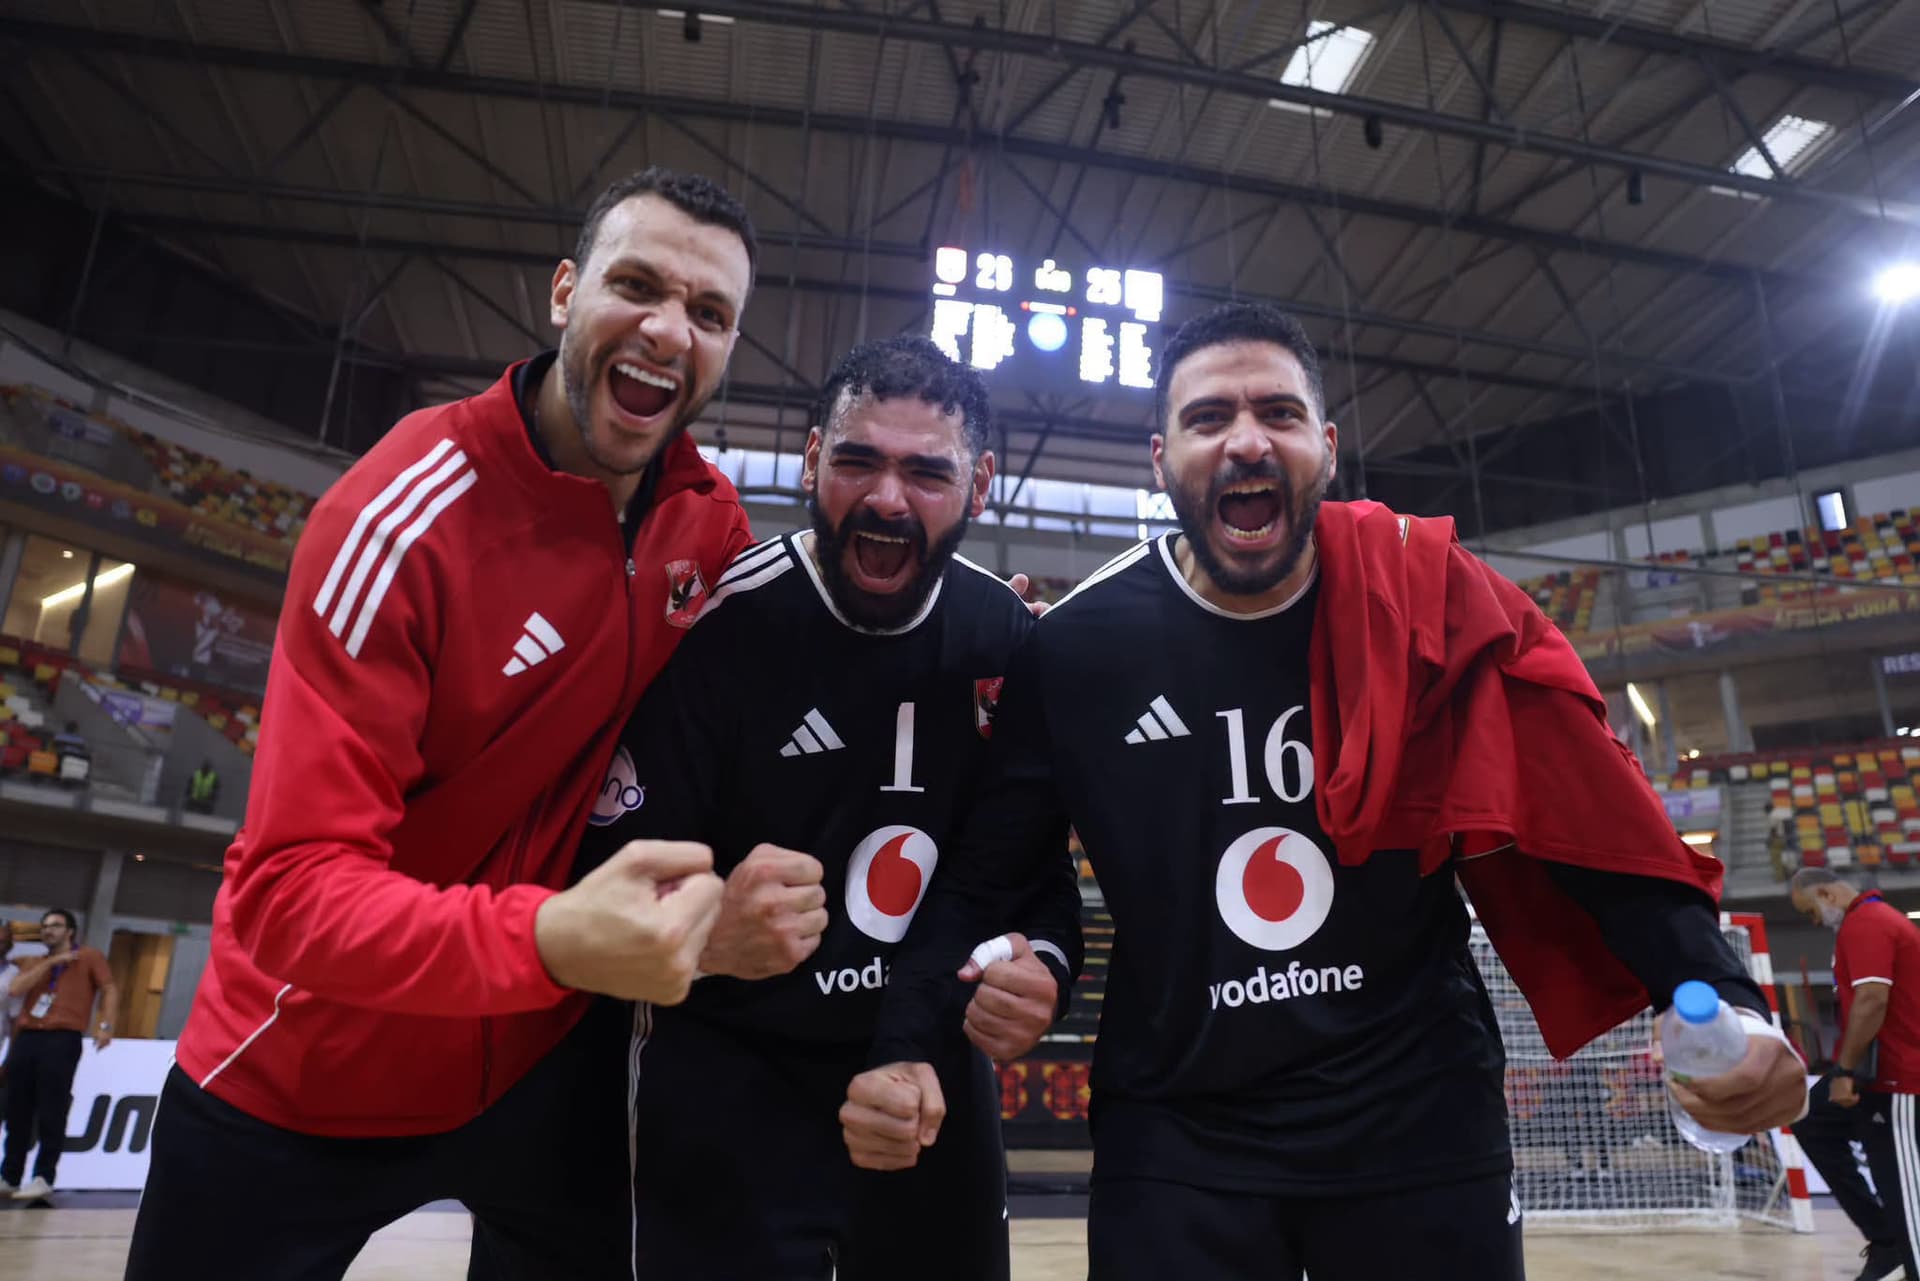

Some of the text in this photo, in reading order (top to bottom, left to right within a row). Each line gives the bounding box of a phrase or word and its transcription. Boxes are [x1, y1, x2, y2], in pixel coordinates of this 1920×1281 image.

[880, 702, 924, 793] 1
[1215, 705, 1314, 804] 16
[1209, 961, 1364, 1010] vodafone
